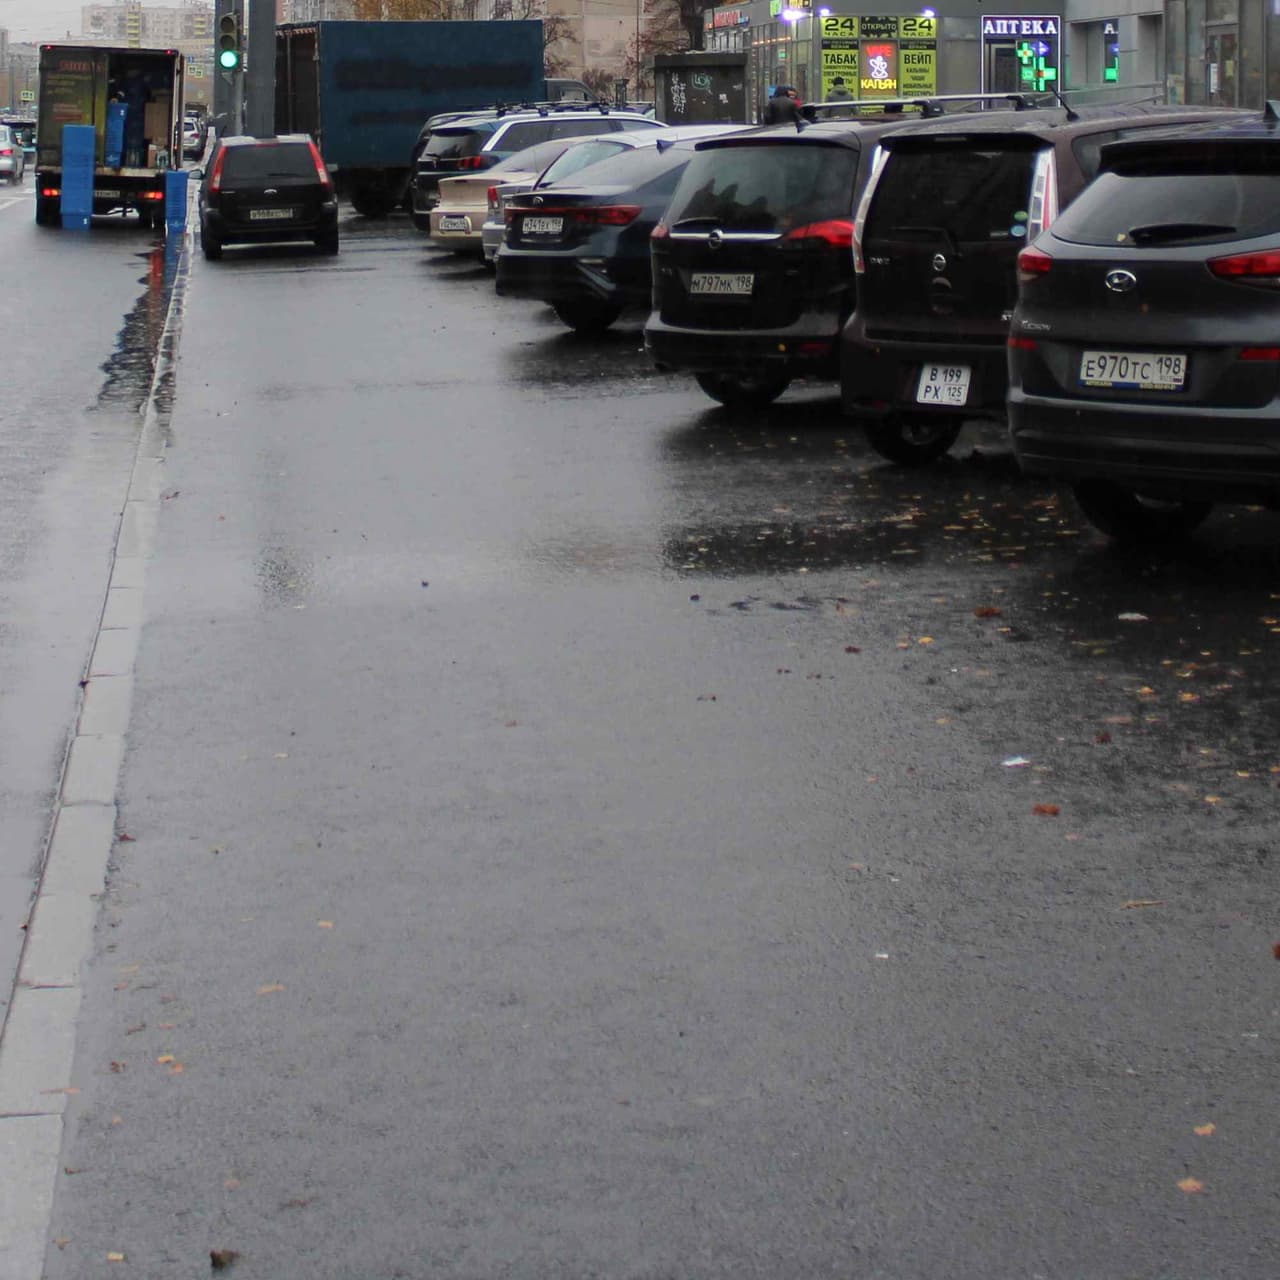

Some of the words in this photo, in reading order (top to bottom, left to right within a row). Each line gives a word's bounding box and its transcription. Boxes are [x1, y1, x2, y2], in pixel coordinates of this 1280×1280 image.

[824, 18, 855, 31] 24
[903, 18, 933, 31] 24
[983, 20, 1057, 35] АПТЕКА
[824, 54, 857, 65] ТАБАК
[904, 52, 932, 65] ВЕЙП
[861, 79, 897, 89] КАЛЬЯН
[1086, 355, 1151, 380] Е970ТС
[1156, 357, 1182, 375] 198
